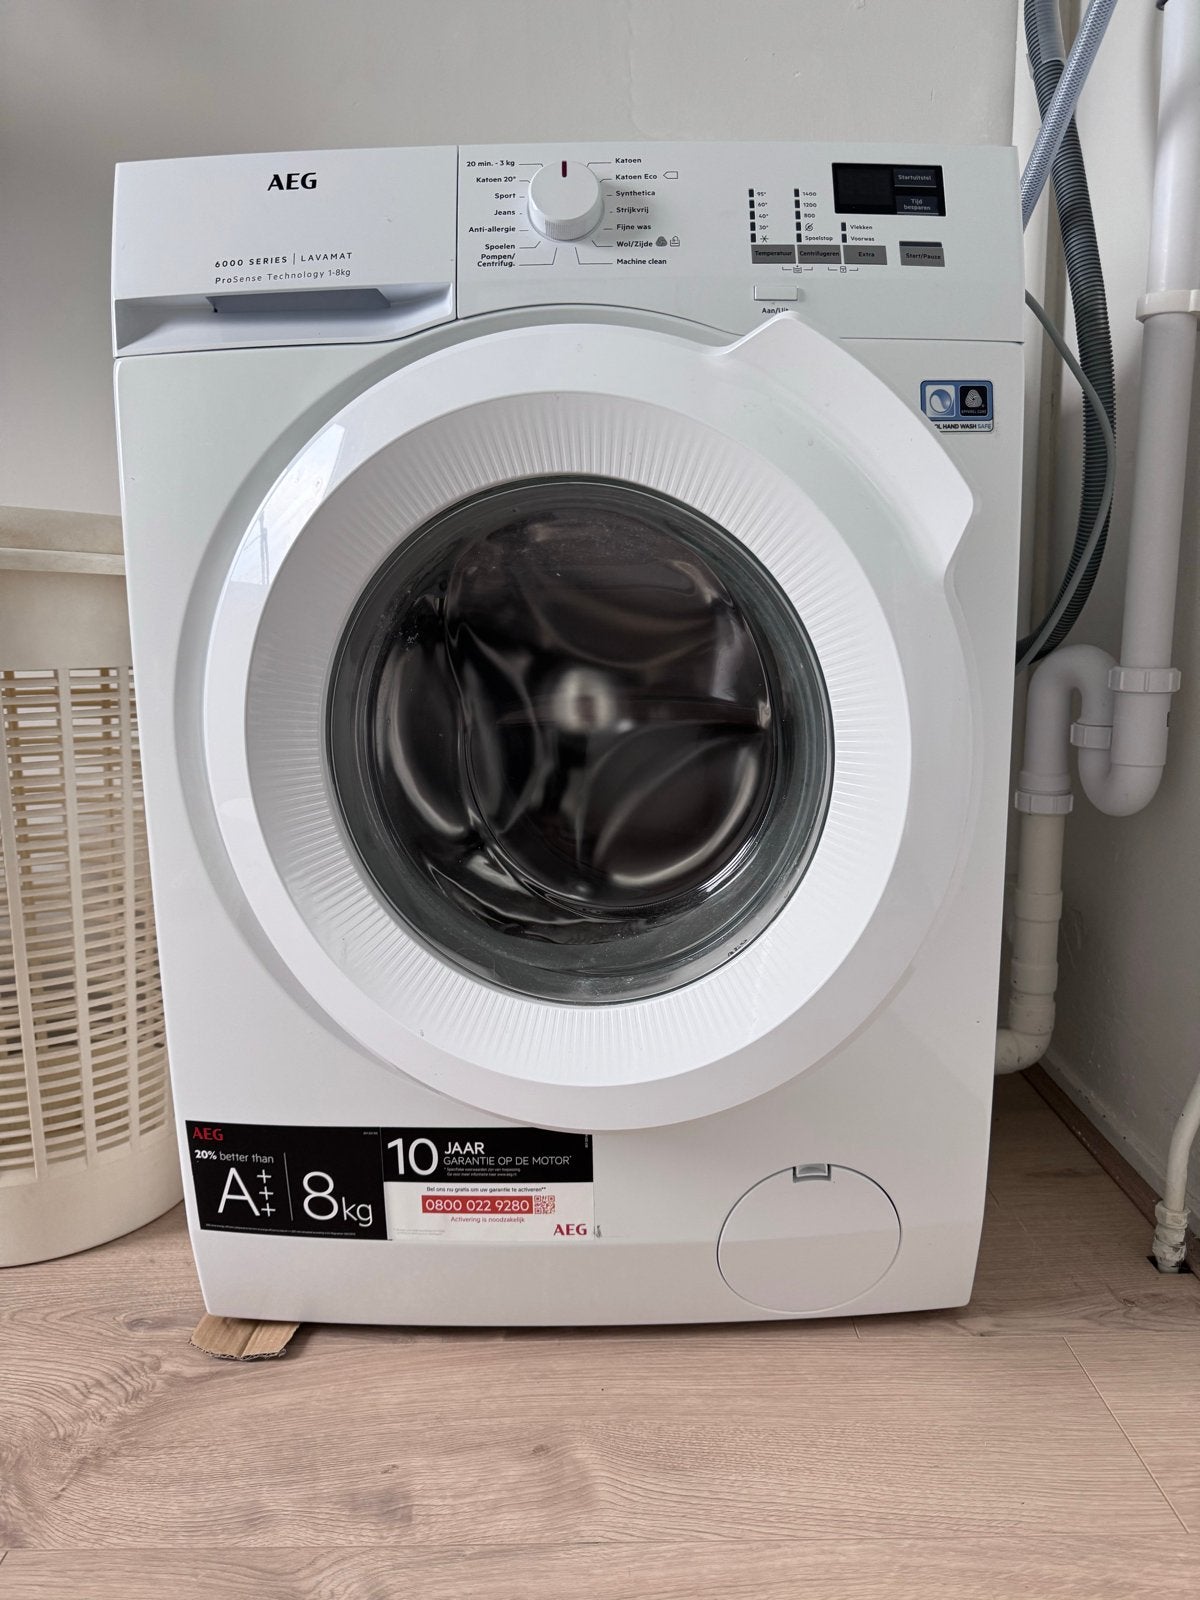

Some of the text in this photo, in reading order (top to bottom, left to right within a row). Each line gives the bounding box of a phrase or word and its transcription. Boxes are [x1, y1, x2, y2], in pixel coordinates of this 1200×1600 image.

[466, 160, 478, 168] 20
[506, 160, 515, 168] kg
[267, 172, 318, 191] AEG
[503, 175, 517, 183] 20°
[494, 192, 516, 200] Sport
[615, 190, 656, 198] Synthetica
[616, 206, 649, 215] Strijkvrij
[468, 226, 516, 234] Anti-allergie
[616, 223, 636, 231] Fijne
[484, 243, 516, 251] Spoelen
[616, 240, 653, 249] Wol/Zijde
[480, 253, 515, 261] Pompen/
[799, 250, 840, 258] Centrifugeren
[214, 252, 353, 268] 6000 SERIES LAVAMAT
[477, 260, 516, 268] Centrifug.
[214, 268, 351, 284] ProSense Technology 1-8kg
[192, 1126, 224, 1142] AEG
[444, 1141, 485, 1155] JAAR
[194, 1149, 274, 1164] 20% better than
[387, 1137, 439, 1176] 10
[443, 1156, 495, 1166] GARANTIE
[497, 1156, 513, 1166] OP
[515, 1156, 529, 1166] DE
[425, 1199, 530, 1211] 0800 022 9280
[450, 1216, 481, 1224] Activering
[553, 1223, 588, 1236] AEG
